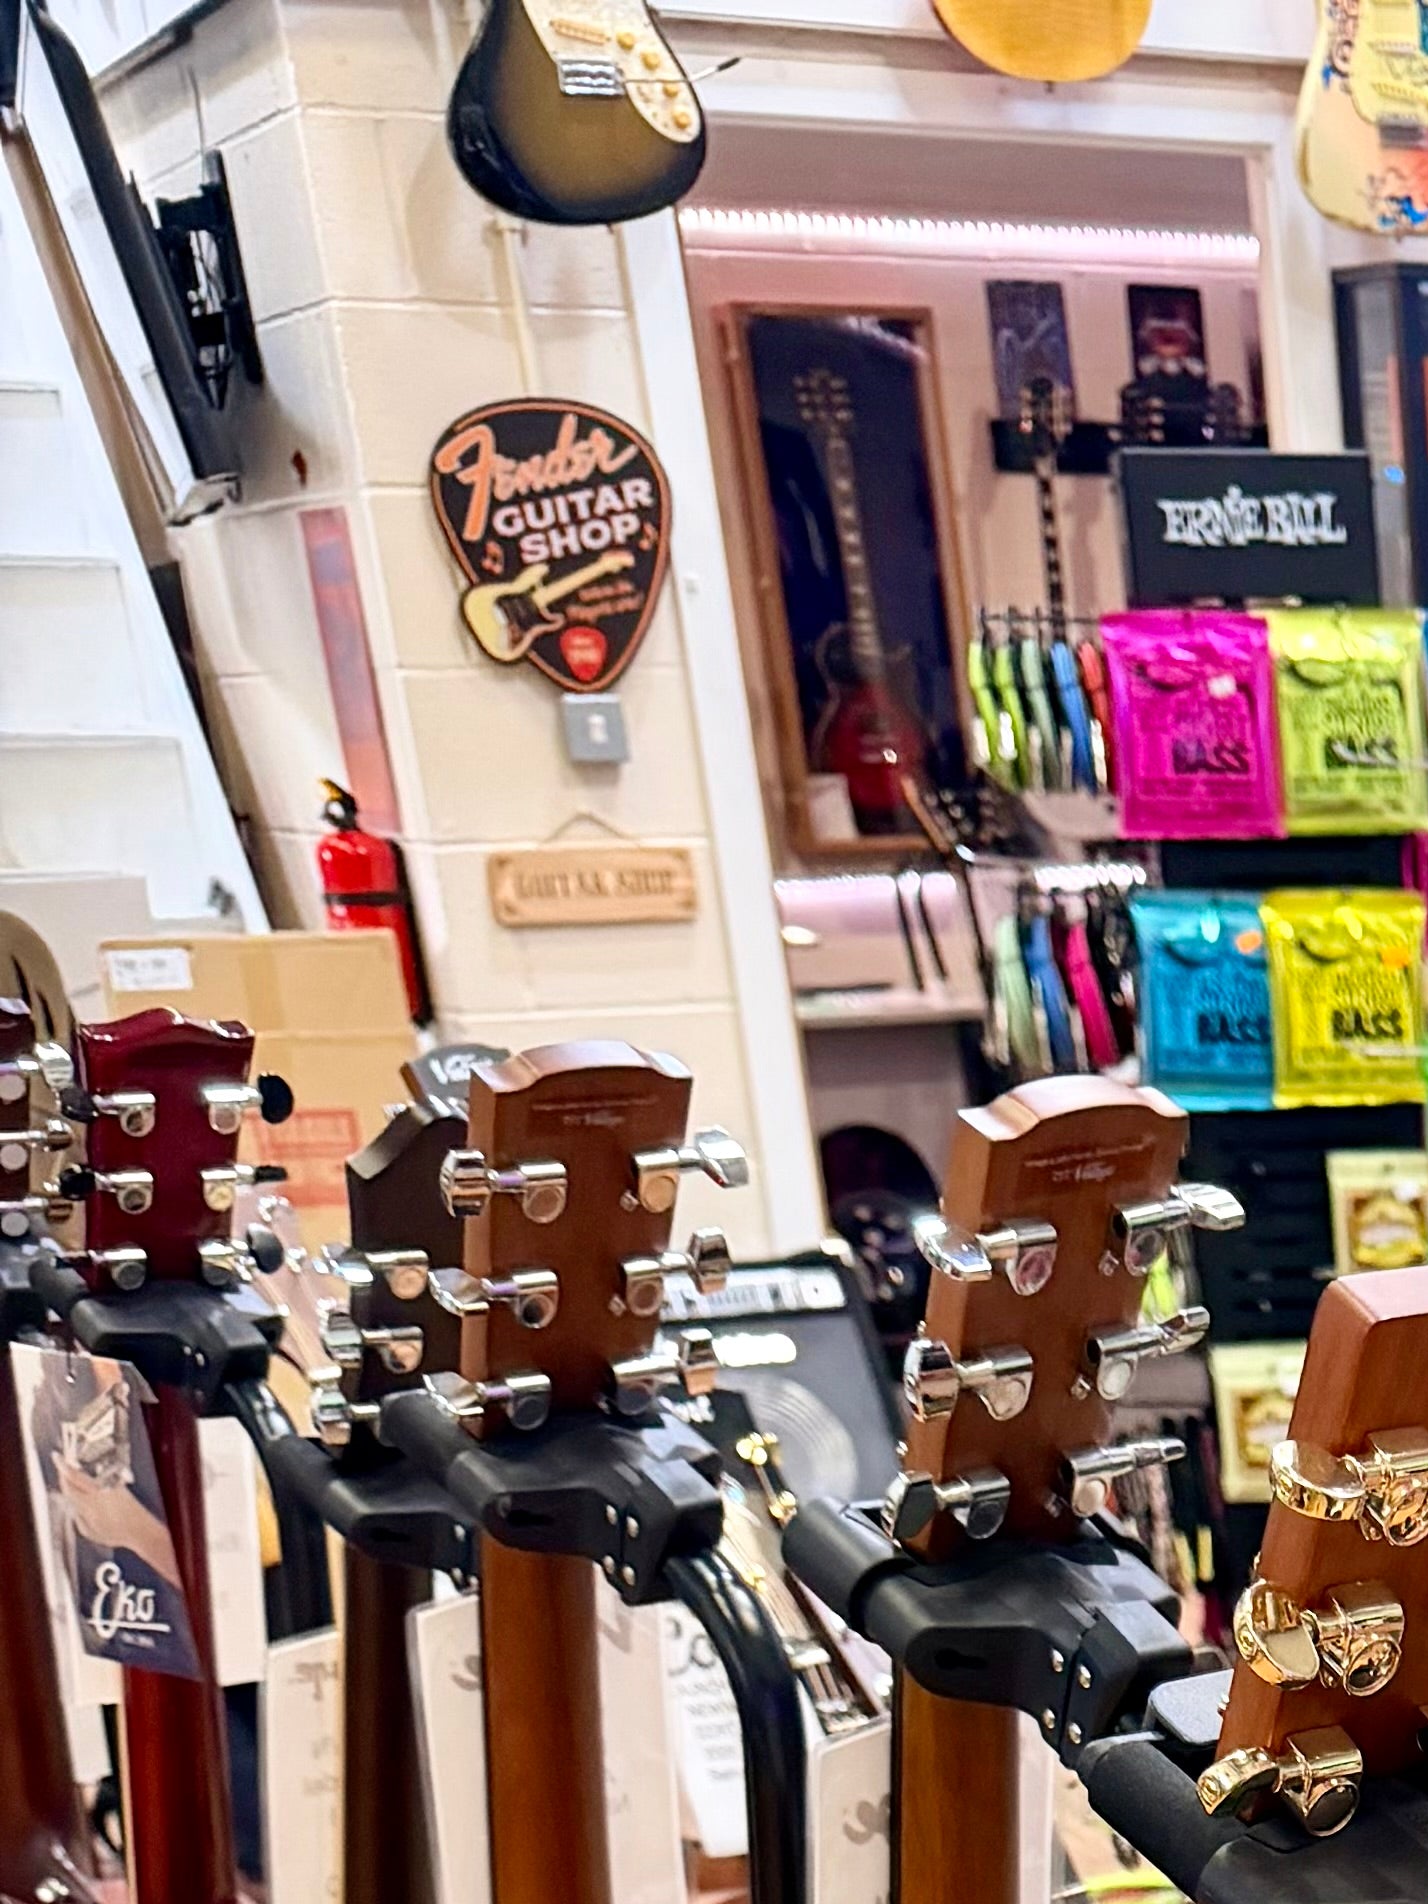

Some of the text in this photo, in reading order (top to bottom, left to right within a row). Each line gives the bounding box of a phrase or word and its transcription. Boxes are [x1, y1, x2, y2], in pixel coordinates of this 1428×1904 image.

[435, 413, 638, 541] Fender
[492, 476, 654, 536] GUITAR
[520, 513, 640, 564] SHOP
[1157, 483, 1347, 546] ERNIE BALL
[91, 1561, 156, 1640] Eko
